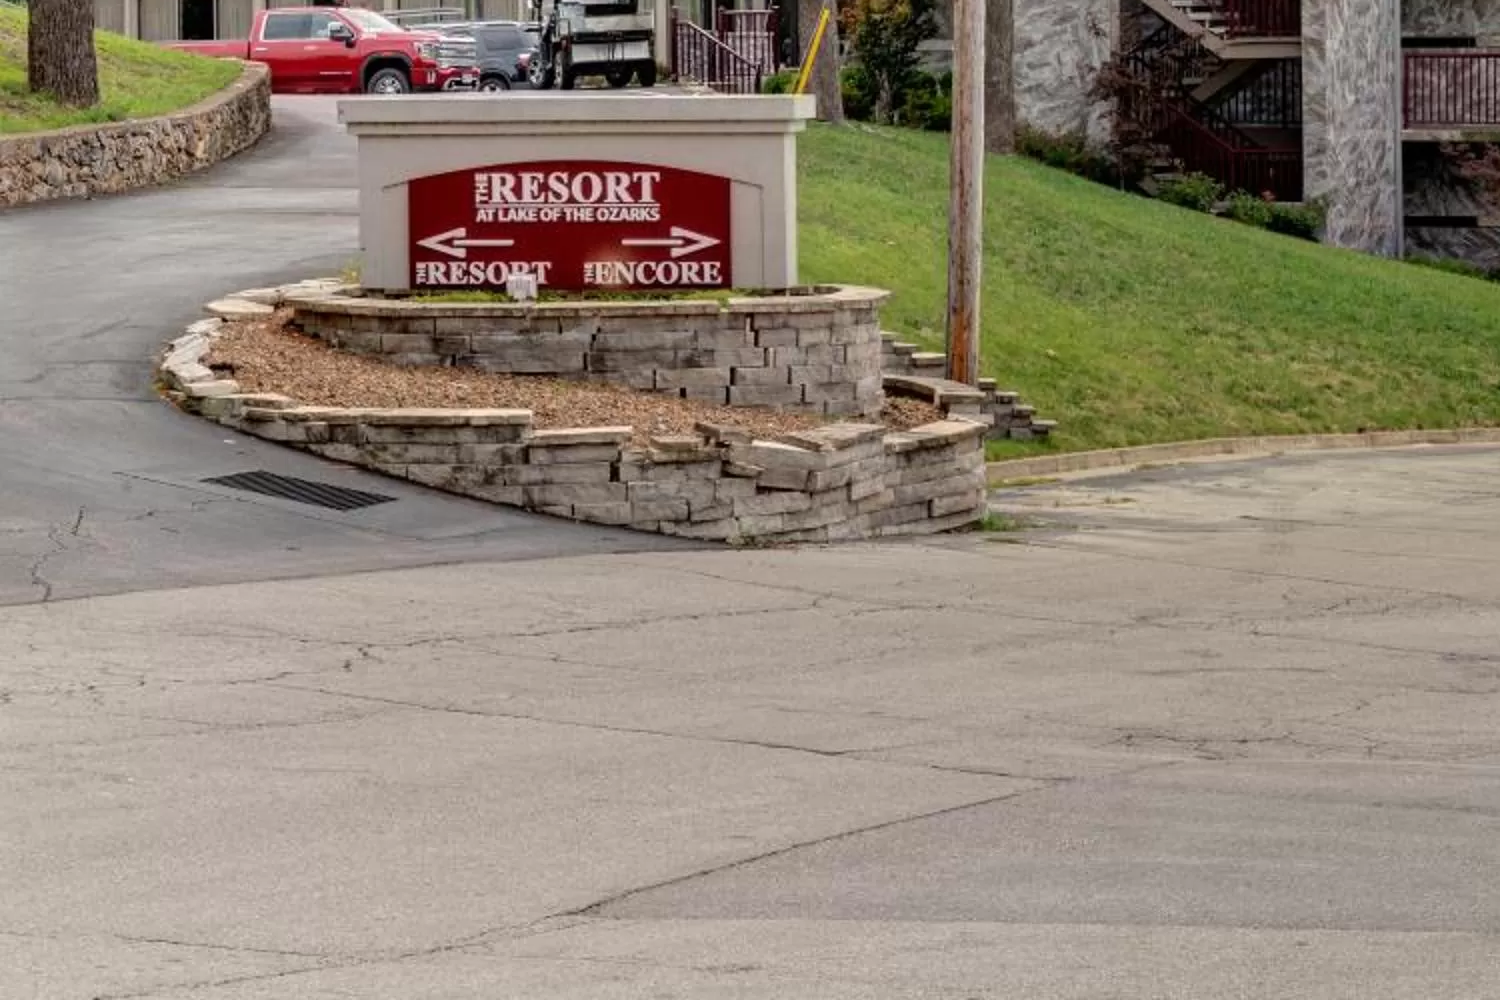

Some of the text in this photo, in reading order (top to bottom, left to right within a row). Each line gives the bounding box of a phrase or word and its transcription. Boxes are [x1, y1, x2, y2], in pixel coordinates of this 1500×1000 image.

[474, 171, 660, 204] THE RESORT
[476, 206, 660, 222] AT LAKE OF THE OZARKS
[415, 261, 552, 285] THE RESORT
[583, 261, 722, 285] THE ENCORE
